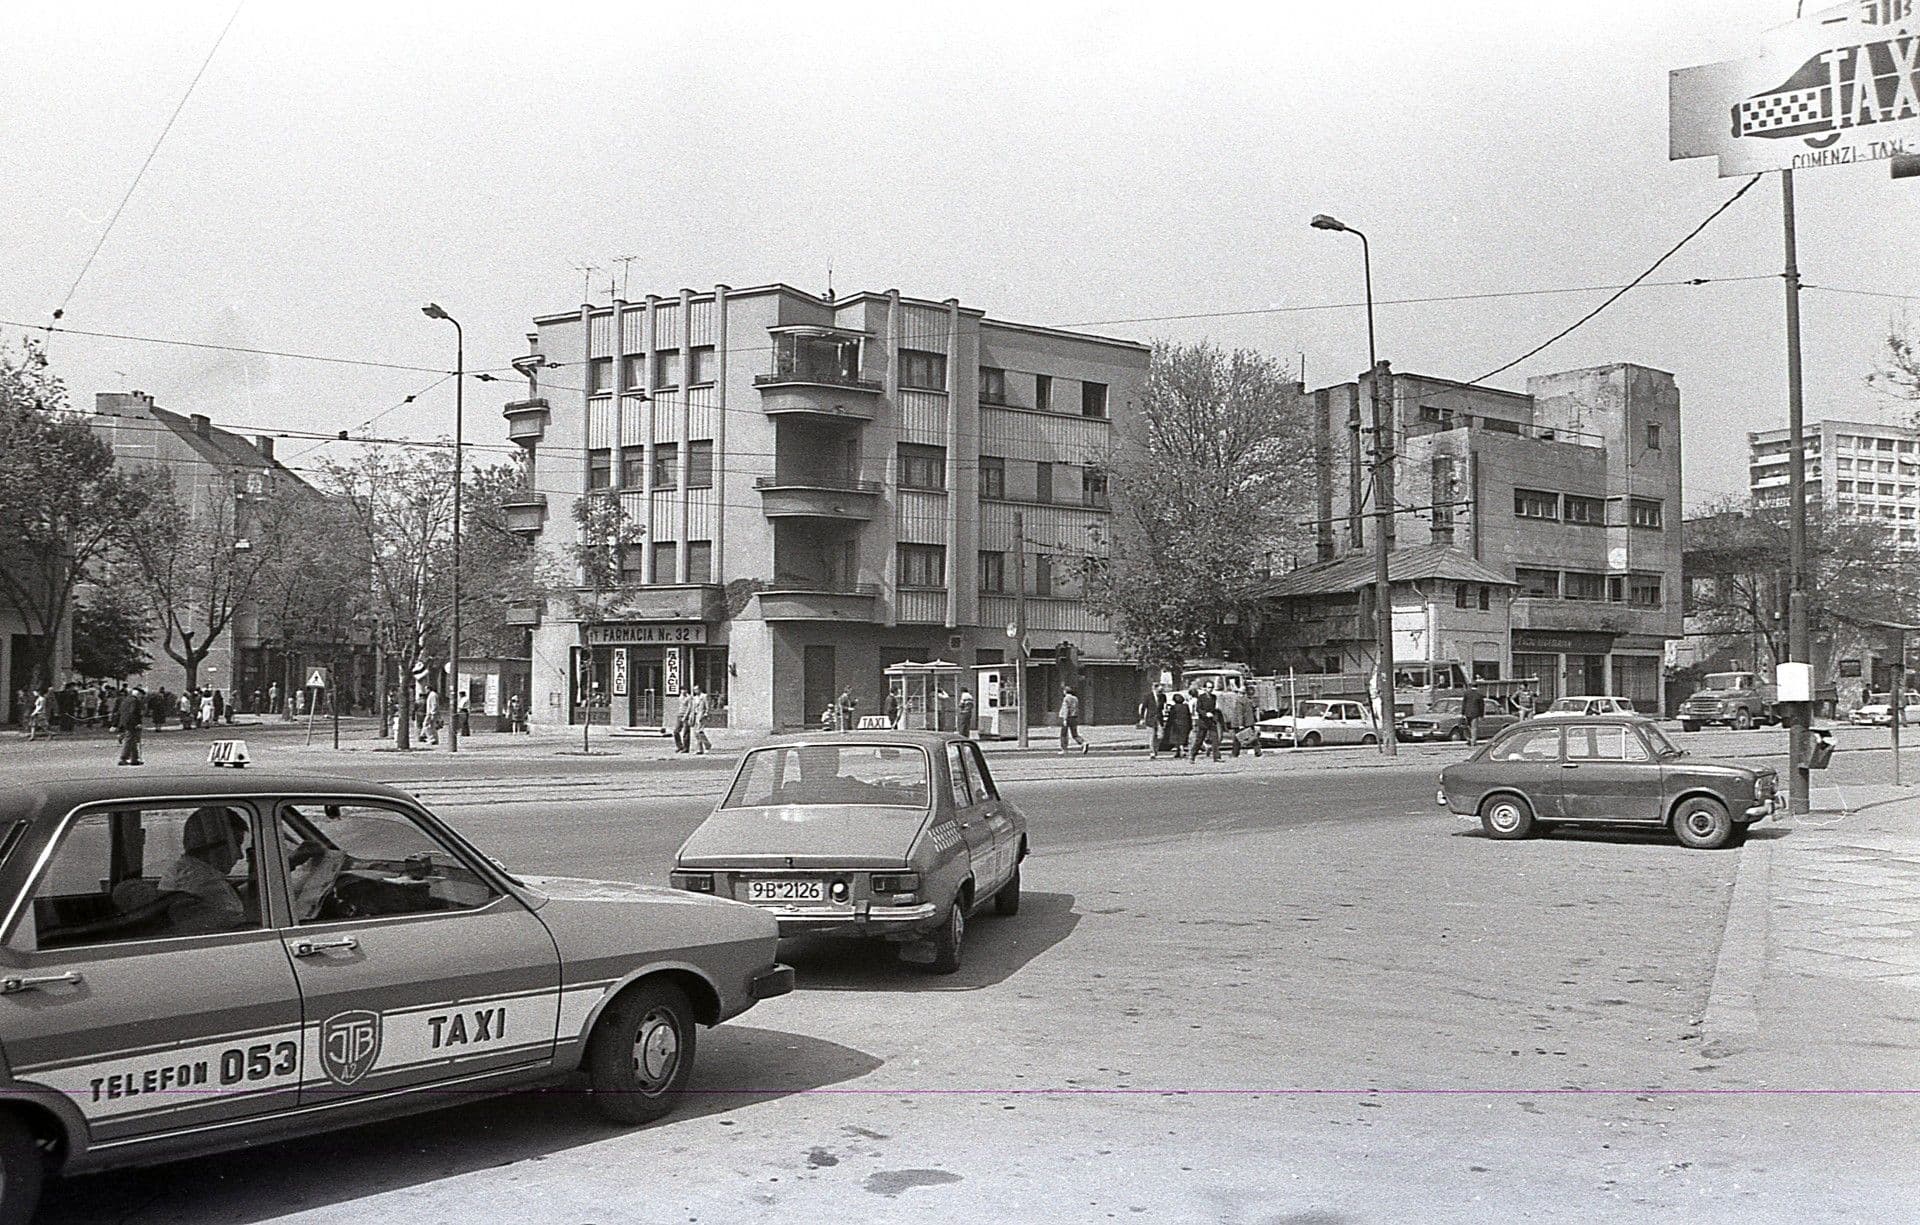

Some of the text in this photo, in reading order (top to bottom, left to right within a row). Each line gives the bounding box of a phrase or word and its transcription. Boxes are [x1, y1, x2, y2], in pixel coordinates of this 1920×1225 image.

[603, 628, 690, 641] FARMACIA Nr. 32
[862, 717, 885, 728] TAXI
[211, 742, 233, 761] TAXI
[428, 1007, 506, 1048] TAXI
[90, 1041, 297, 1102] TELEFON 053
